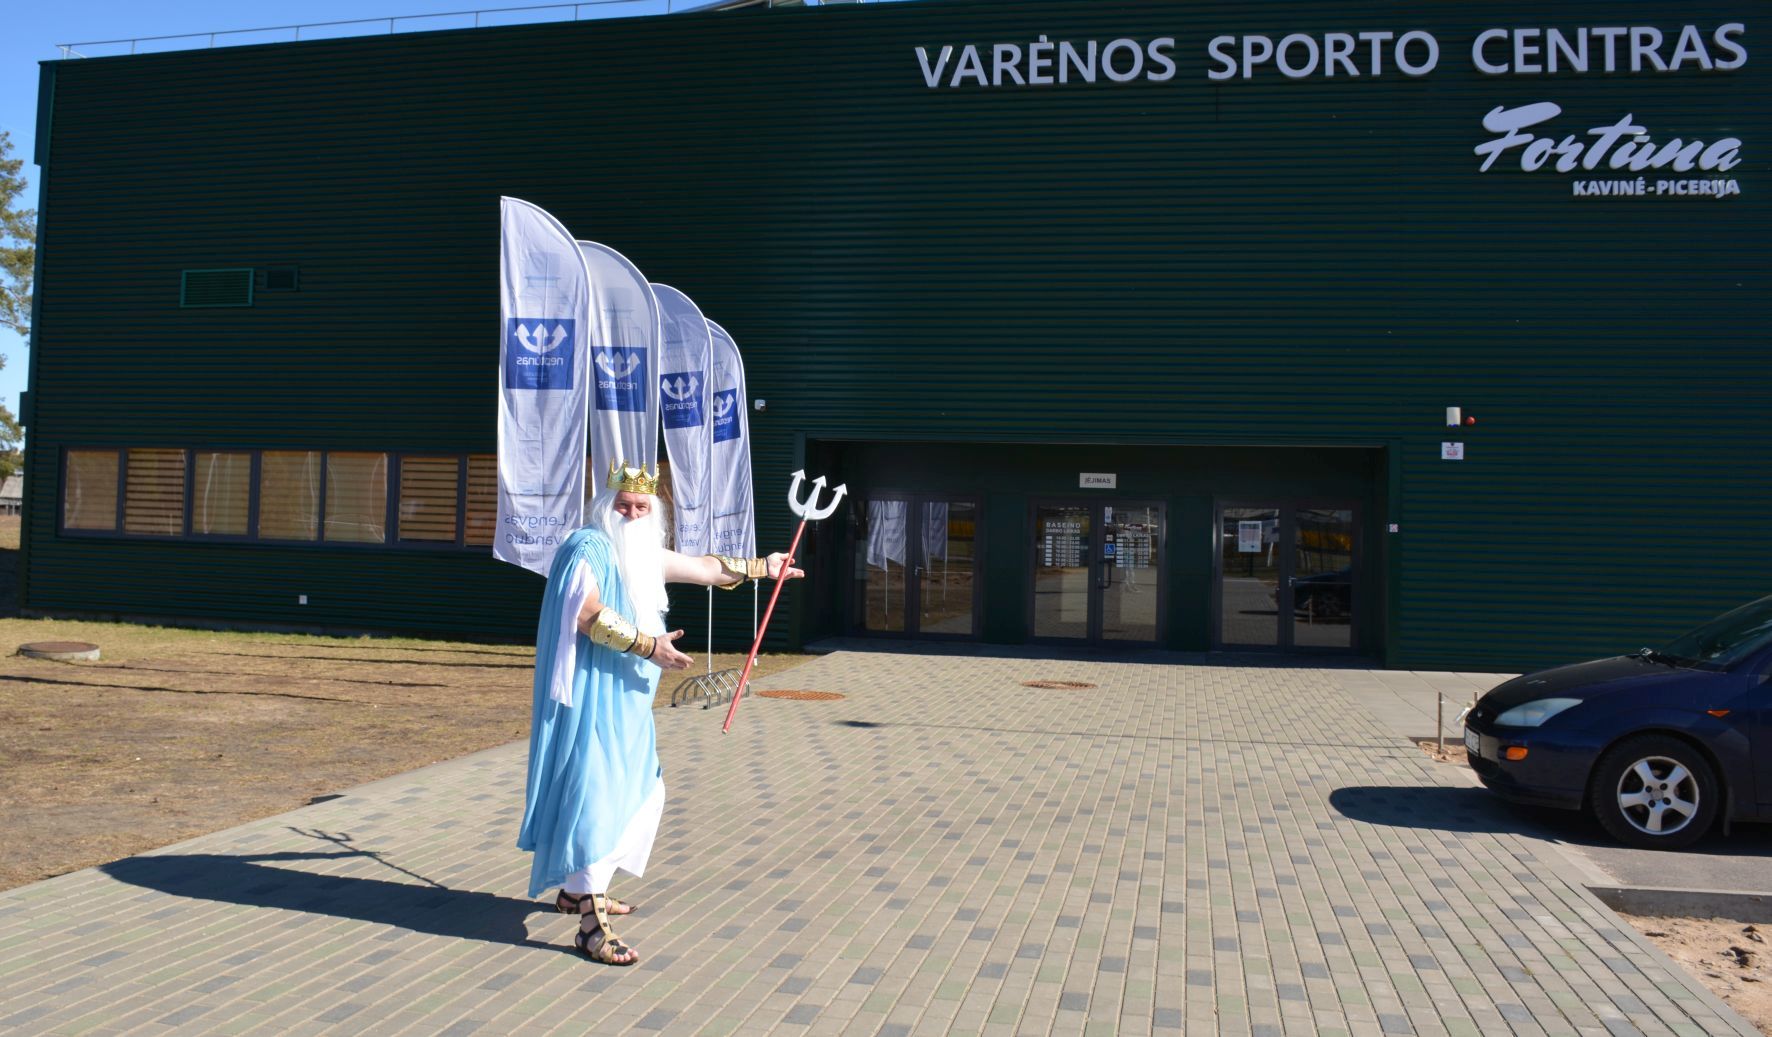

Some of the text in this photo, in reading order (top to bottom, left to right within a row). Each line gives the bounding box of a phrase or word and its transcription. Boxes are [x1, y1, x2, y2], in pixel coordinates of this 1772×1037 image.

[915, 22, 1748, 88] VARĖNOS SPORTO CENTRAS
